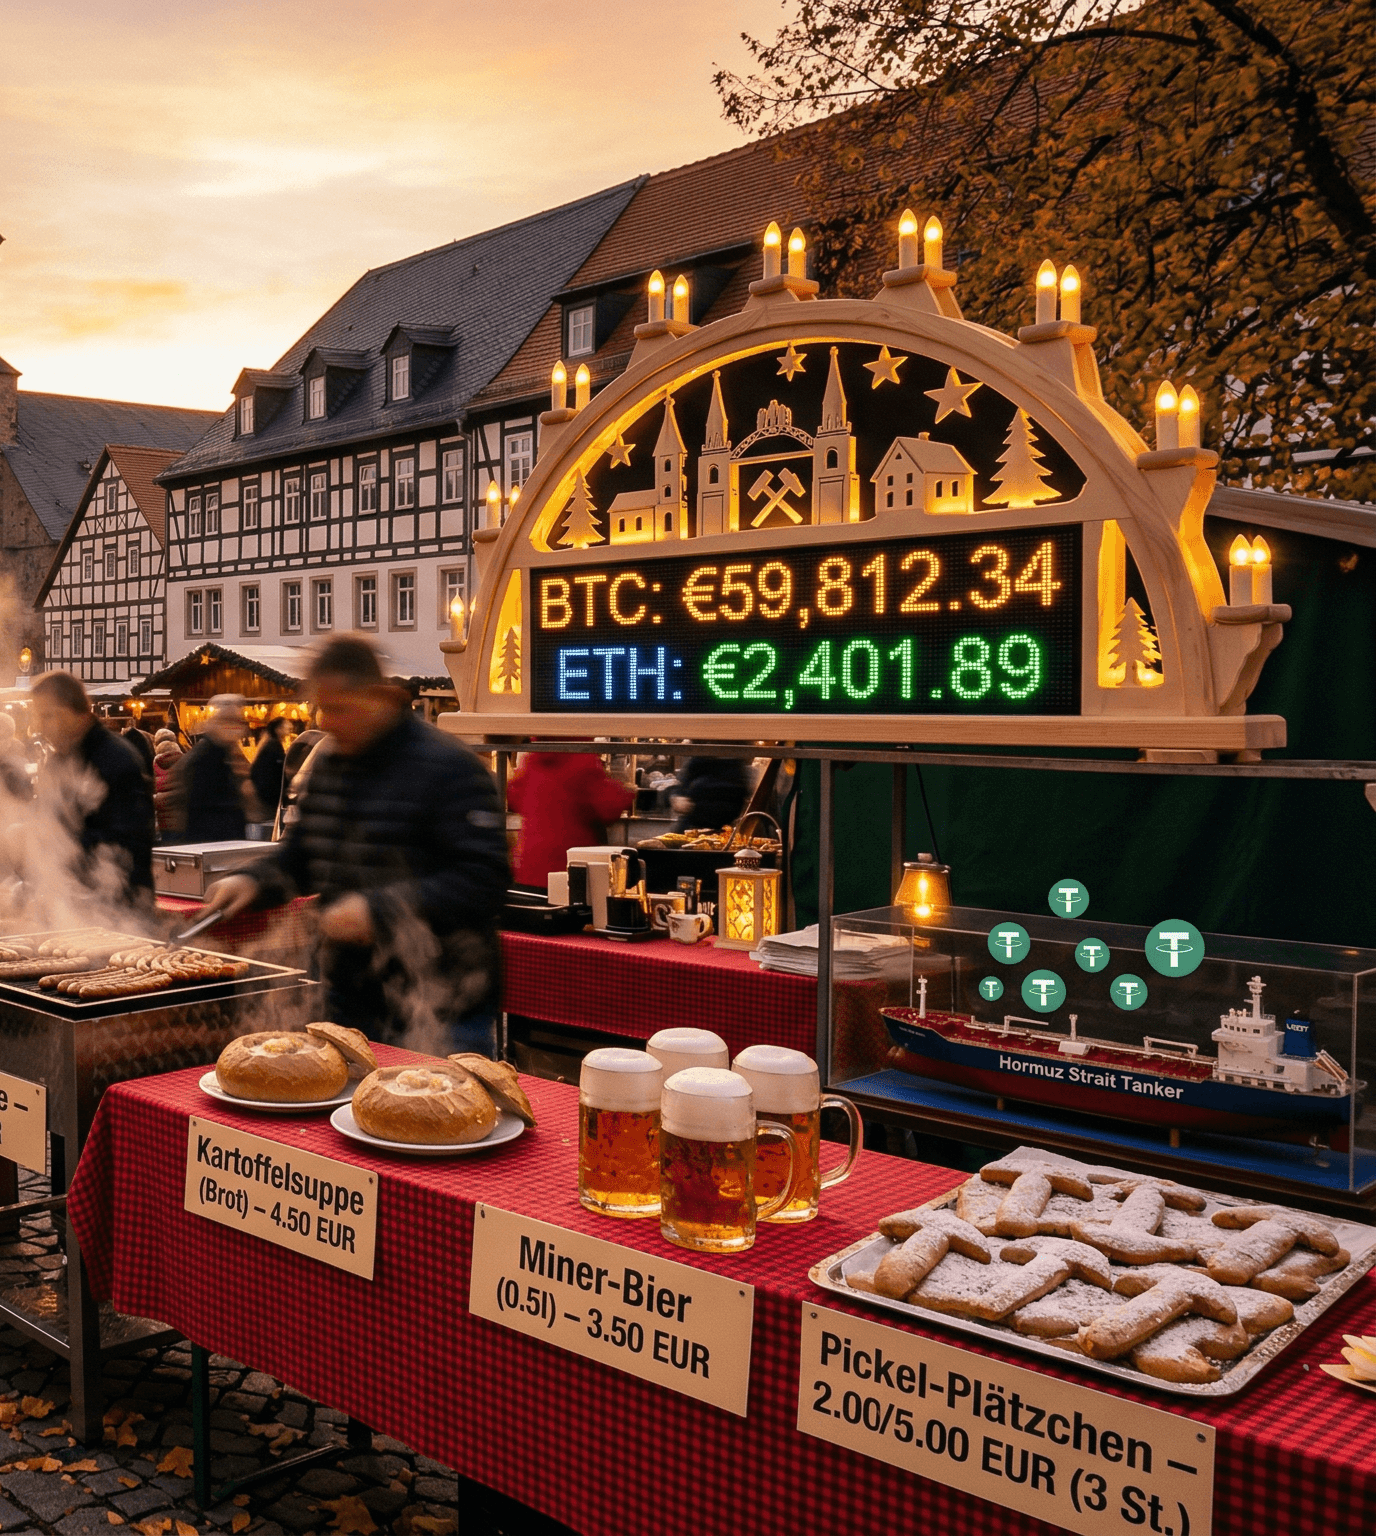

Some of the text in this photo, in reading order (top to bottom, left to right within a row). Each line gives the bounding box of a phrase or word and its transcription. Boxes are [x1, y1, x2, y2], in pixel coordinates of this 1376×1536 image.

[540, 541, 1061, 629] BTC: €59,812.34
[558, 634, 1043, 709] ETH: €2,401.89
[999, 1054, 1184, 1099] Hormuz Strait Tanker
[197, 1134, 364, 1216] Kartoffelsuppe
[199, 1176, 249, 1220] (Brot)
[270, 1201, 311, 1237] 4.50
[316, 1215, 356, 1254] EUR
[519, 1234, 692, 1323] Miner-Bier
[496, 1276, 556, 1329] (0.5l)
[586, 1307, 644, 1354] 3.50
[652, 1329, 710, 1380] EUR
[820, 1330, 1153, 1474] Pickel-Plätzchen
[812, 1380, 1191, 1536] 2.00/5.00 EUR (3 St.)
